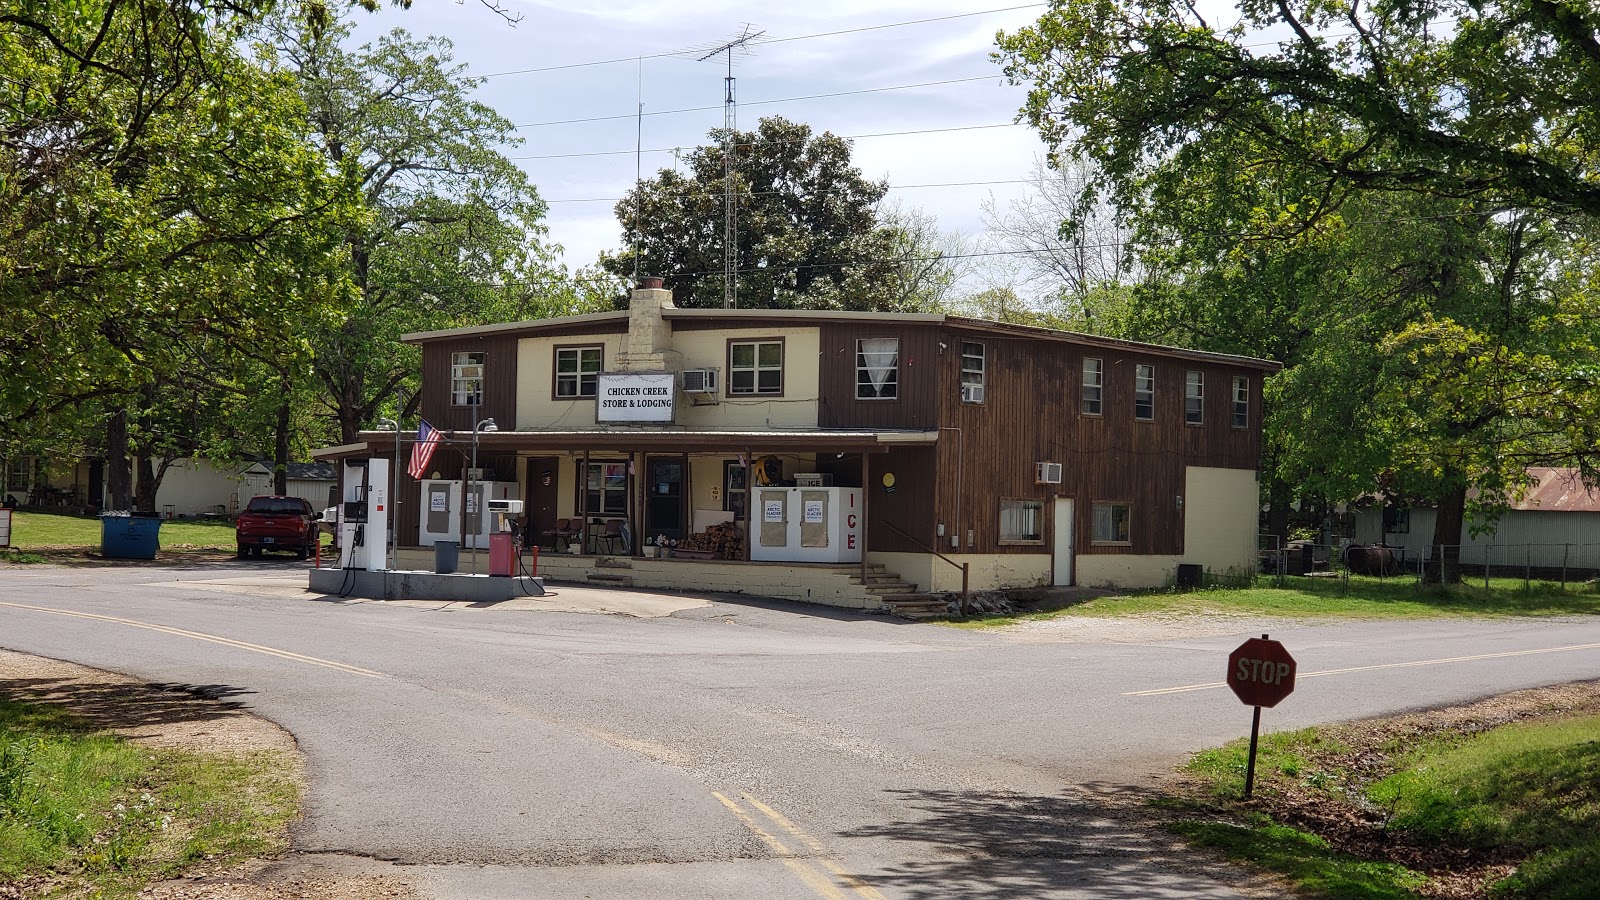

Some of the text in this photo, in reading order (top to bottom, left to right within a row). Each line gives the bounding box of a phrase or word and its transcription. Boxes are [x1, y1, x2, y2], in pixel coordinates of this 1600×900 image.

[607, 387, 668, 396] CHICKEN CREEK
[602, 399, 672, 408] STORE & LODGING
[847, 493, 857, 550] ICE
[1236, 657, 1290, 686] STOP
